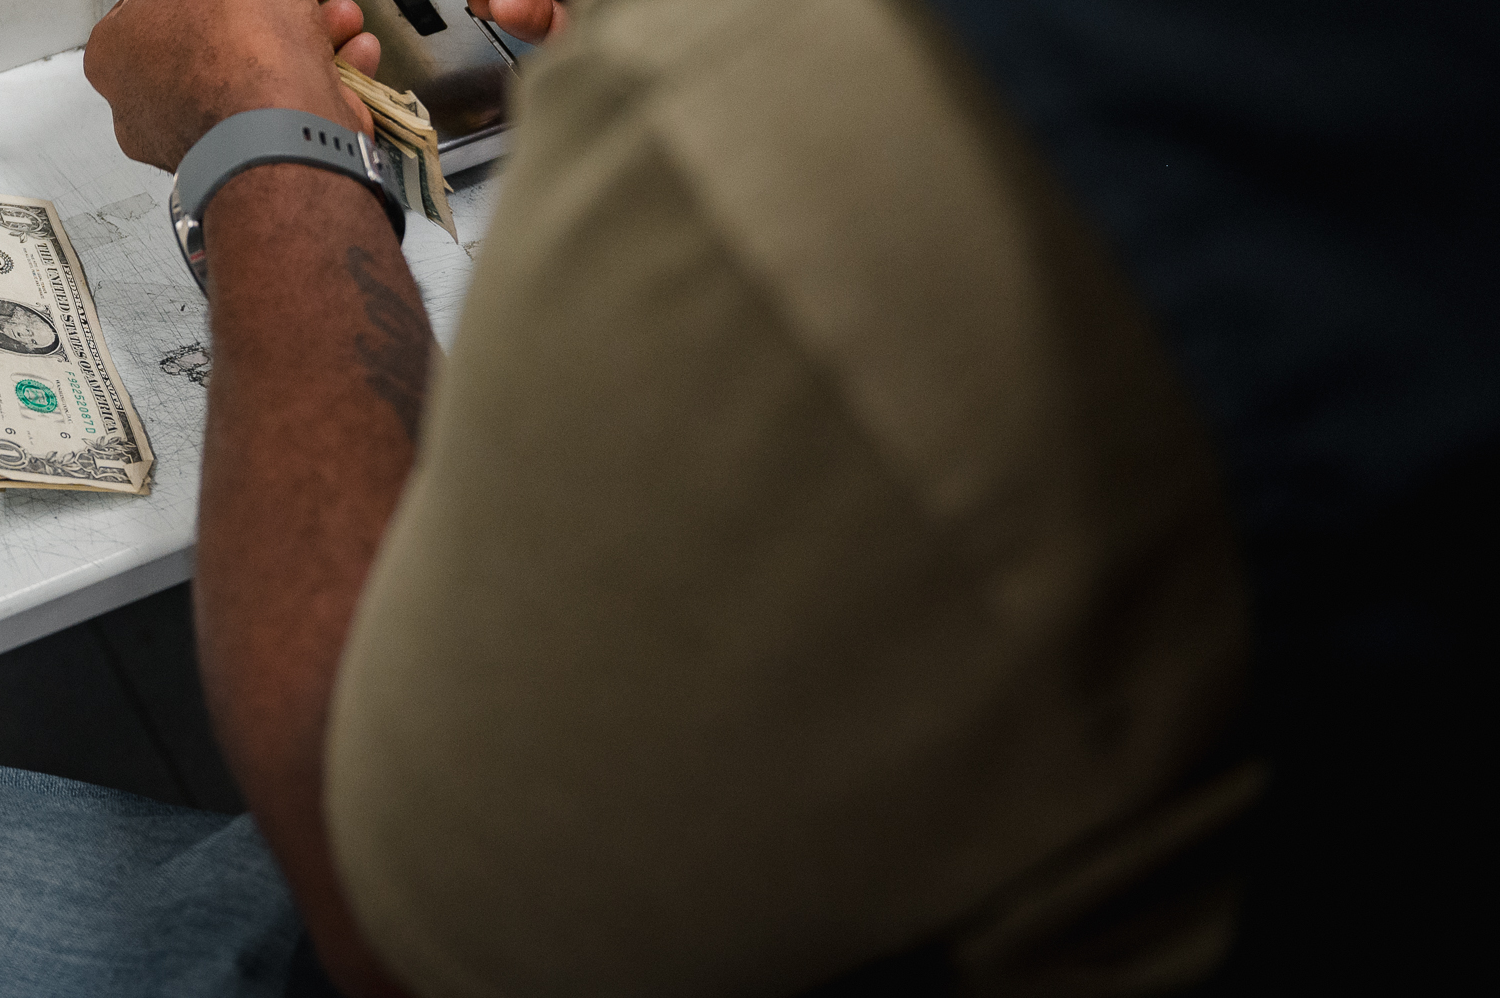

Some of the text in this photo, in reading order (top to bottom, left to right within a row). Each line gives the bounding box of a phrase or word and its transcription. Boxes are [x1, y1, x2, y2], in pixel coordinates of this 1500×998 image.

[35, 242, 55, 266] THE
[47, 266, 71, 313] UNITED
[60, 313, 87, 360] STATES
[77, 360, 94, 379] OF
[65, 371, 96, 435] F92252087D
[85, 375, 119, 436] AMERICA
